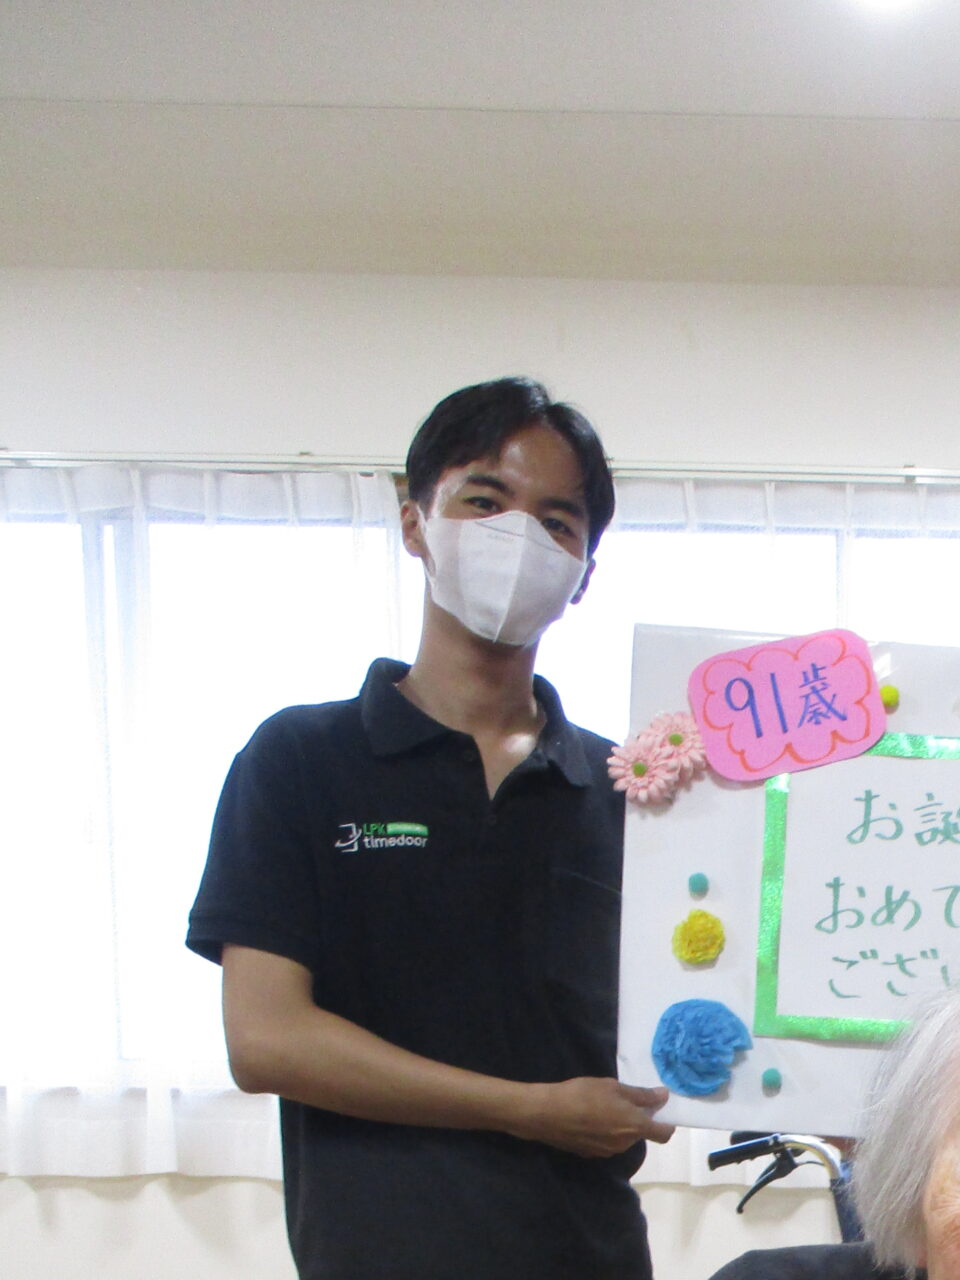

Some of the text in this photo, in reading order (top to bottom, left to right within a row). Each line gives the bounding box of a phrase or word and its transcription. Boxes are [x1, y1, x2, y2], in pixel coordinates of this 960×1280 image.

[724, 662, 848, 738] 91歳
[363, 823, 386, 836] LPK
[363, 834, 428, 849] timedoor
